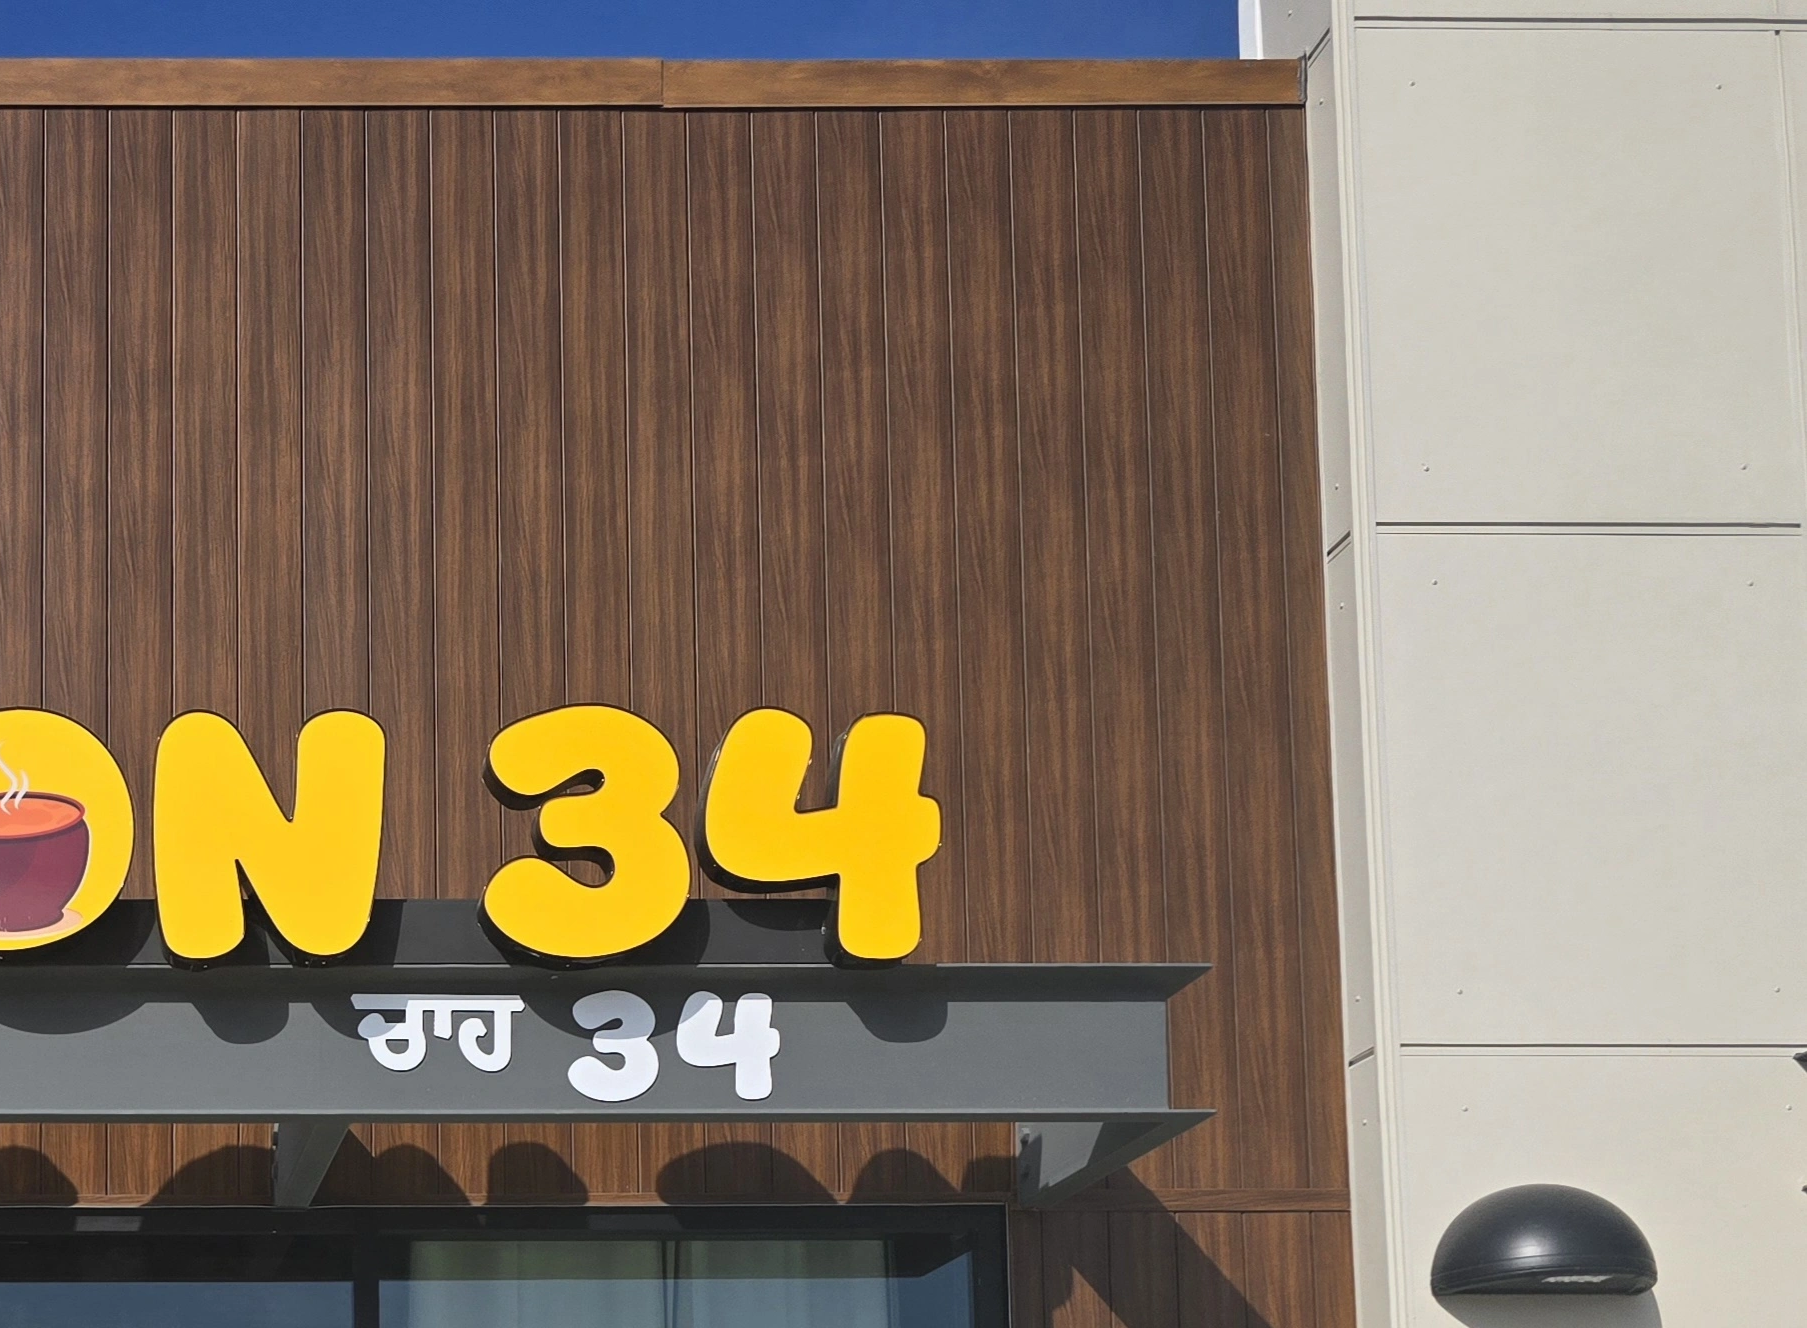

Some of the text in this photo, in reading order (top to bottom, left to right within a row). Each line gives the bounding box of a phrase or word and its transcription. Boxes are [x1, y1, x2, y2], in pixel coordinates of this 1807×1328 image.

[477, 702, 942, 963] 34
[350, 989, 781, 1102] ਚਾਹ 34
